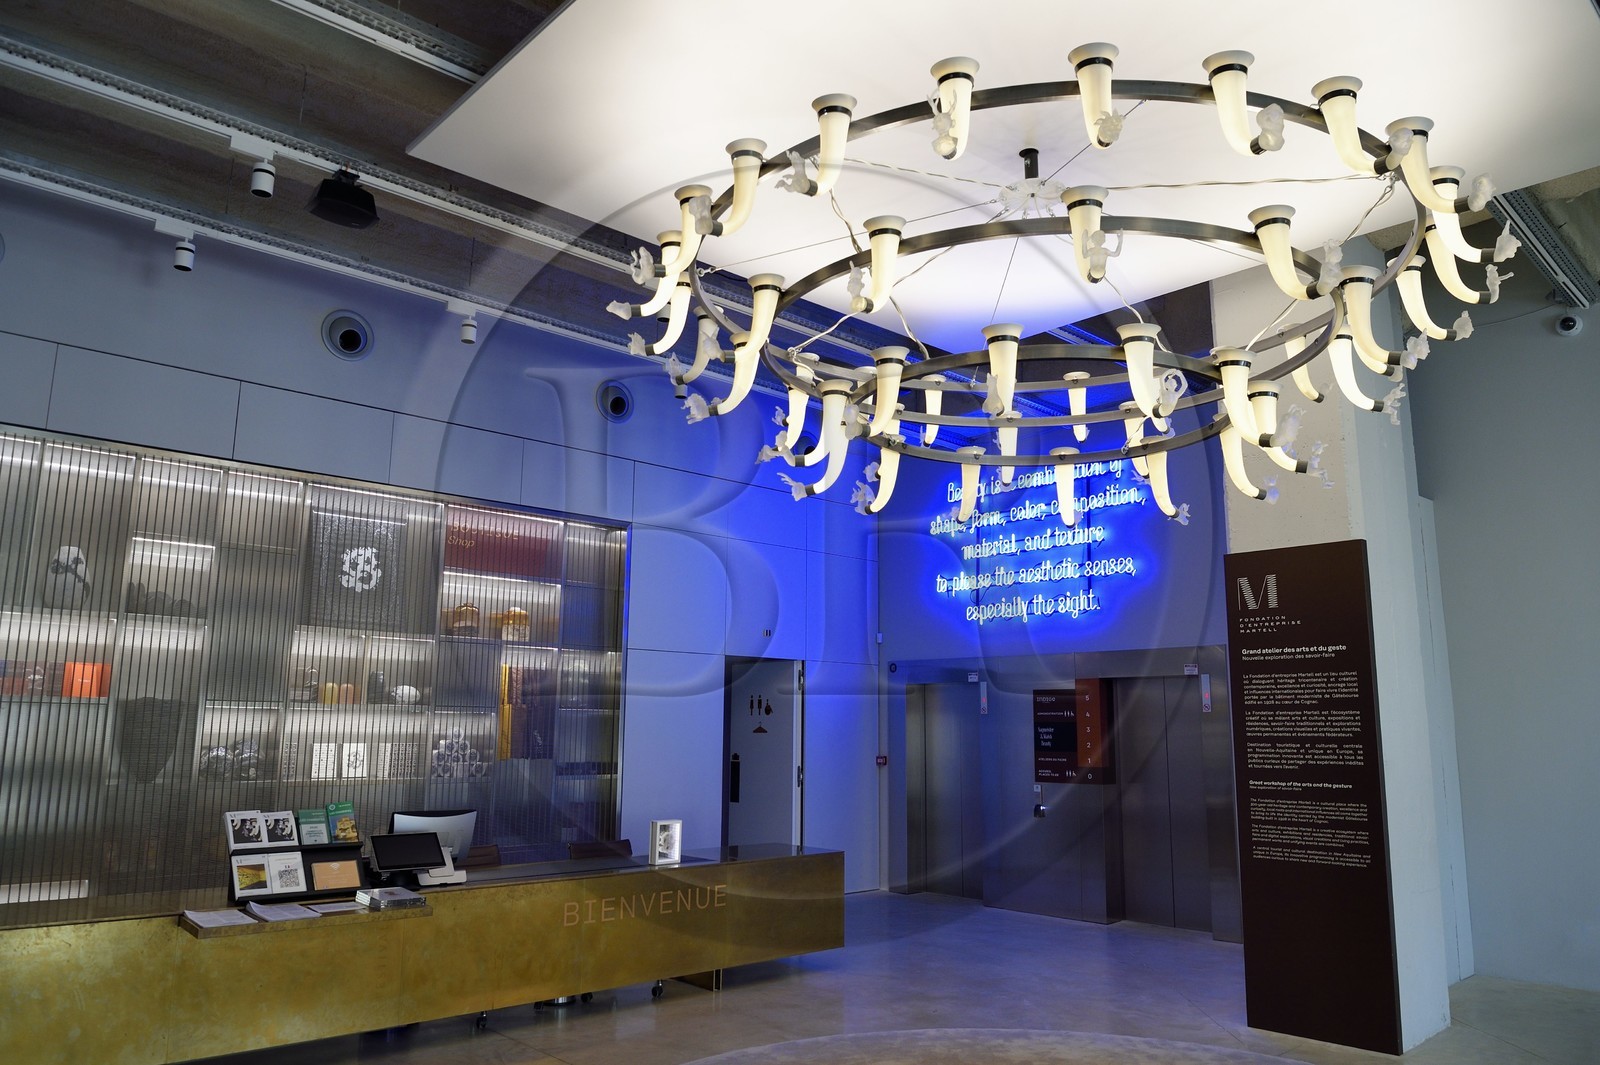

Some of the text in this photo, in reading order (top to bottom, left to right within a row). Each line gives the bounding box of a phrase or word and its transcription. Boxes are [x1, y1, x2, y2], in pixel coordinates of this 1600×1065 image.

[970, 509, 1006, 534] form,
[1010, 500, 1046, 521] color,
[961, 524, 1104, 560] material, and texture
[952, 572, 992, 596] please
[993, 567, 1016, 587] the
[1018, 558, 1080, 583] aesthetic
[1084, 556, 1136, 576] senses,
[966, 589, 1101, 625] especially the sight.
[563, 884, 727, 926] BIENVENUE
